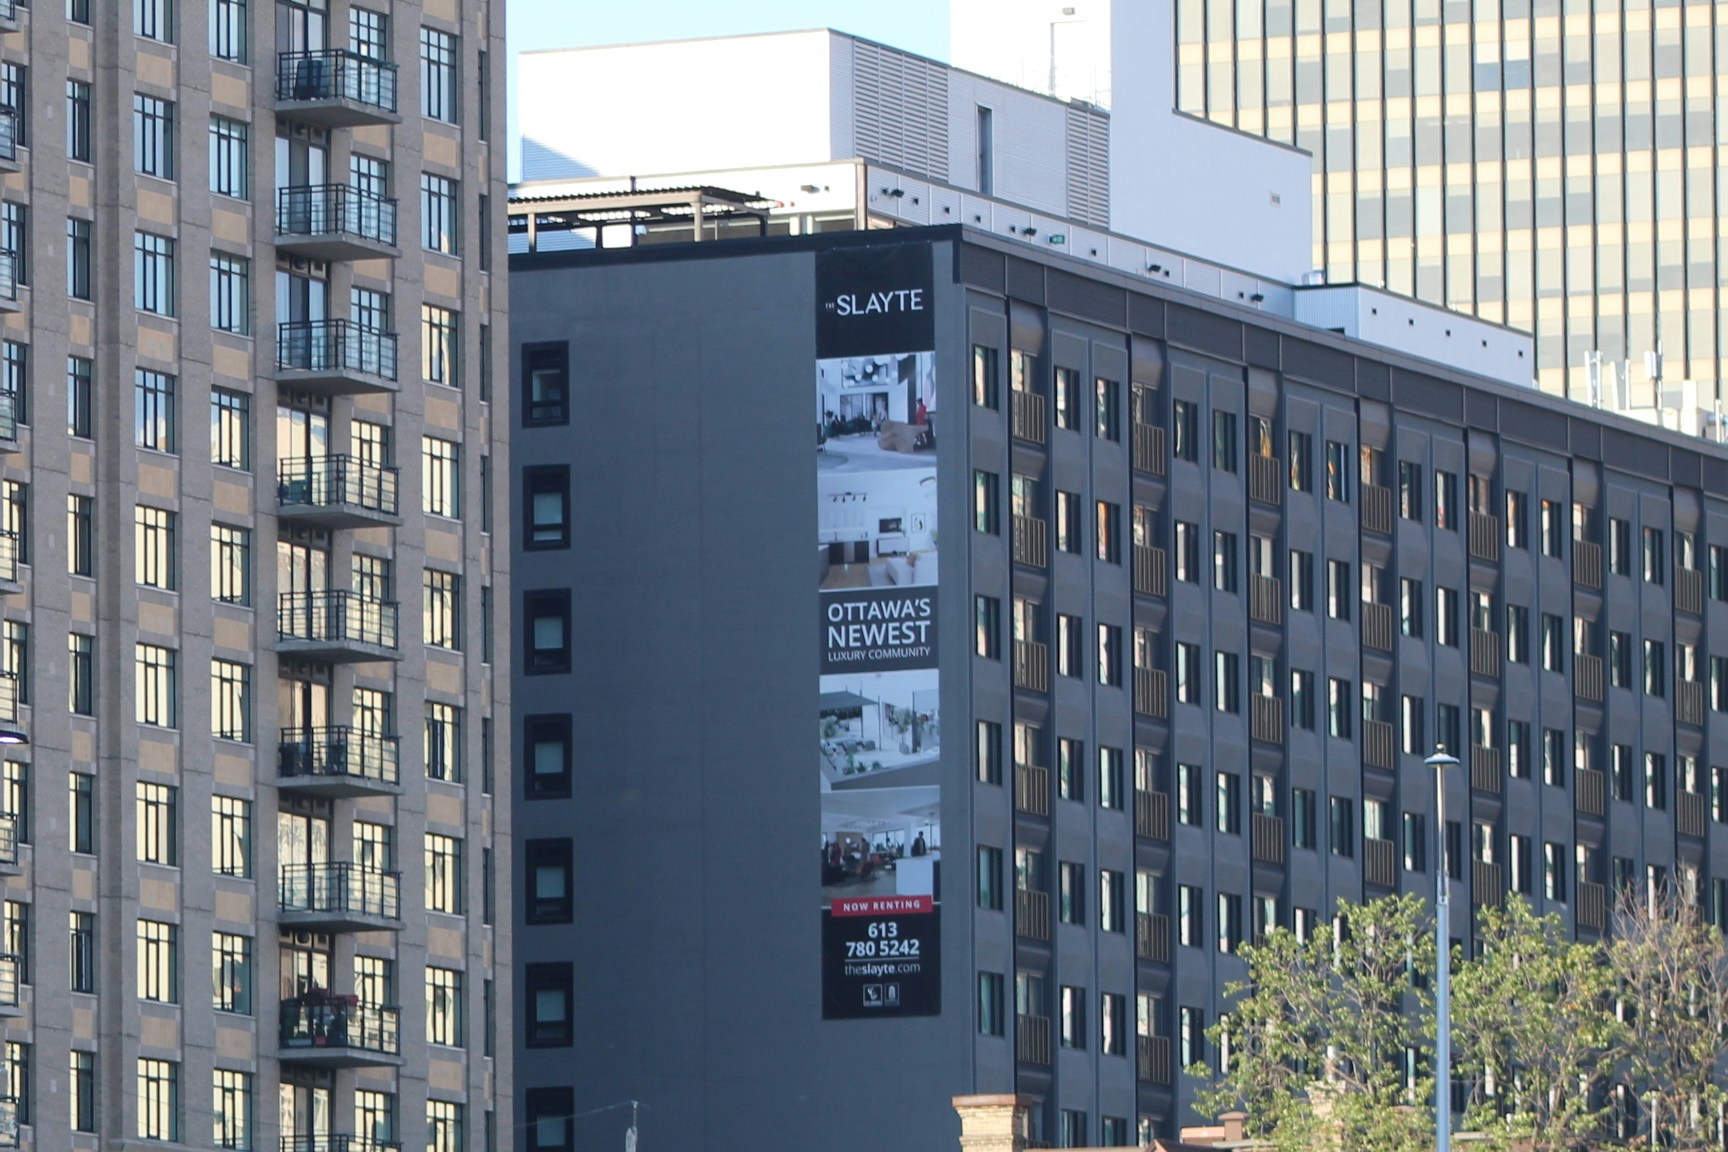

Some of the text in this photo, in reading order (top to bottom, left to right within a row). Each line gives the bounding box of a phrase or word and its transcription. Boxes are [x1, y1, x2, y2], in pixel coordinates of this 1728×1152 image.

[825, 288, 924, 317] THE SLAYTE
[827, 597, 932, 622] OTTAWA'S
[827, 620, 932, 649] NEWEST
[827, 646, 931, 663] LUXURY COMMUNITY
[843, 899, 921, 912] NOW RENTING
[867, 921, 898, 938] 613
[845, 938, 920, 957] 780 5242
[844, 962, 921, 977] theslayte.com
